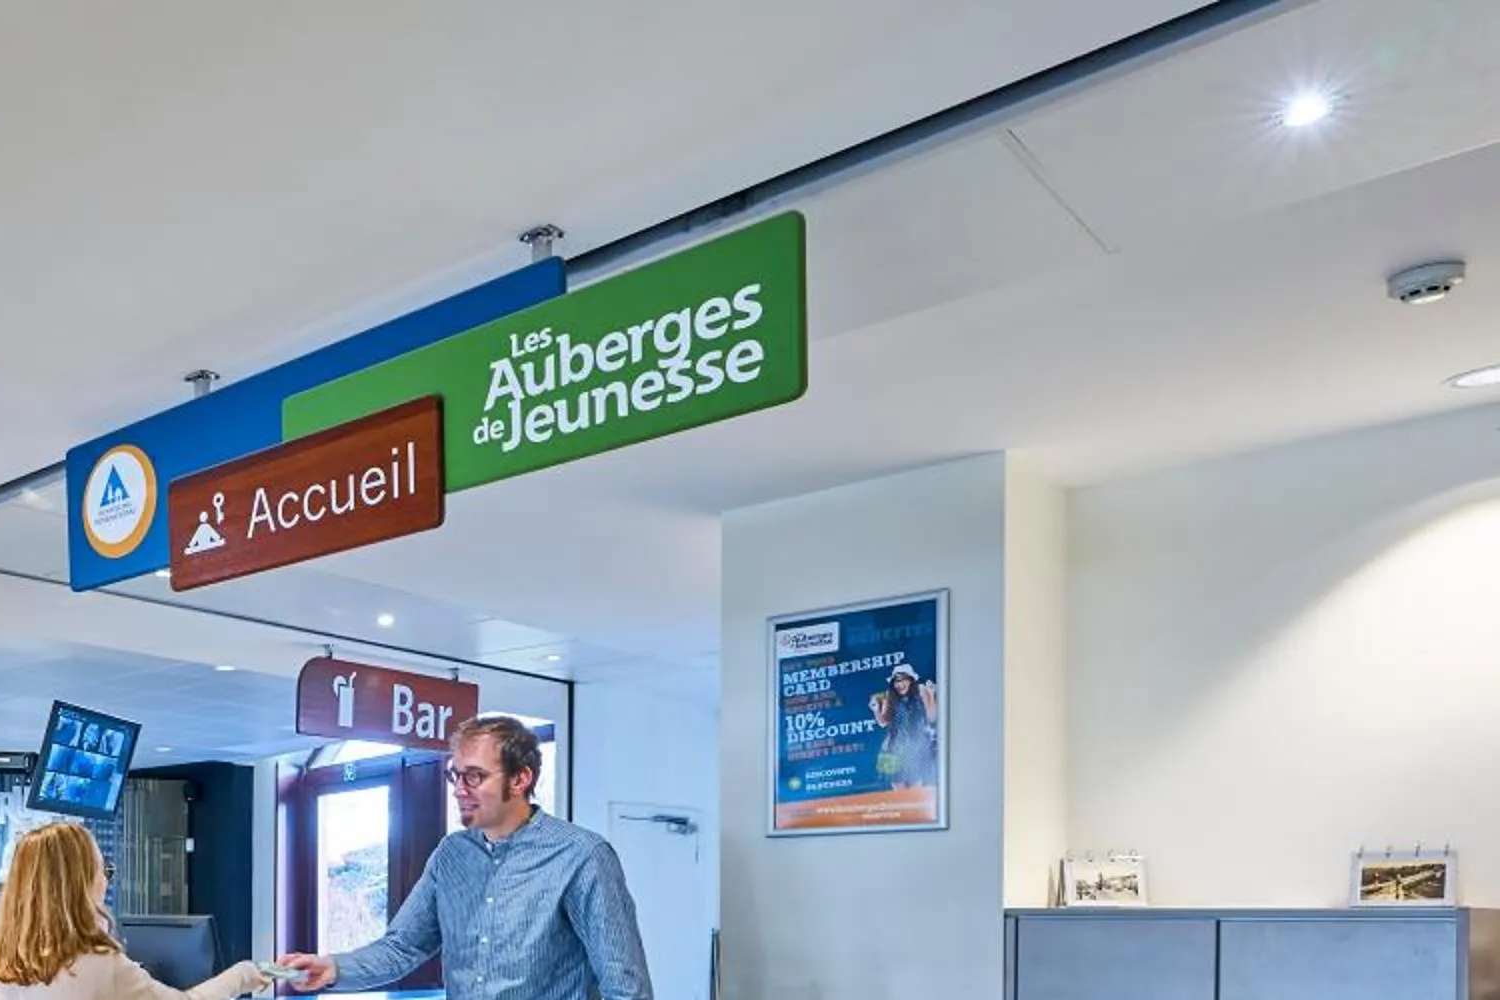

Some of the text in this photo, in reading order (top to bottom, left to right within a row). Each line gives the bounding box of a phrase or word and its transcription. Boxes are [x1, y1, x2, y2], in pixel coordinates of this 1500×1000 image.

[483, 283, 763, 411] Auberges
[509, 327, 553, 358] Les
[472, 339, 765, 452] de Jeunesse
[247, 441, 415, 539] Accueil
[782, 651, 906, 685] MEMBERSHIP
[783, 679, 832, 697] CARD
[392, 683, 453, 741] Bar
[786, 711, 826, 731] 10%
[786, 719, 876, 744] DISCOUNT
